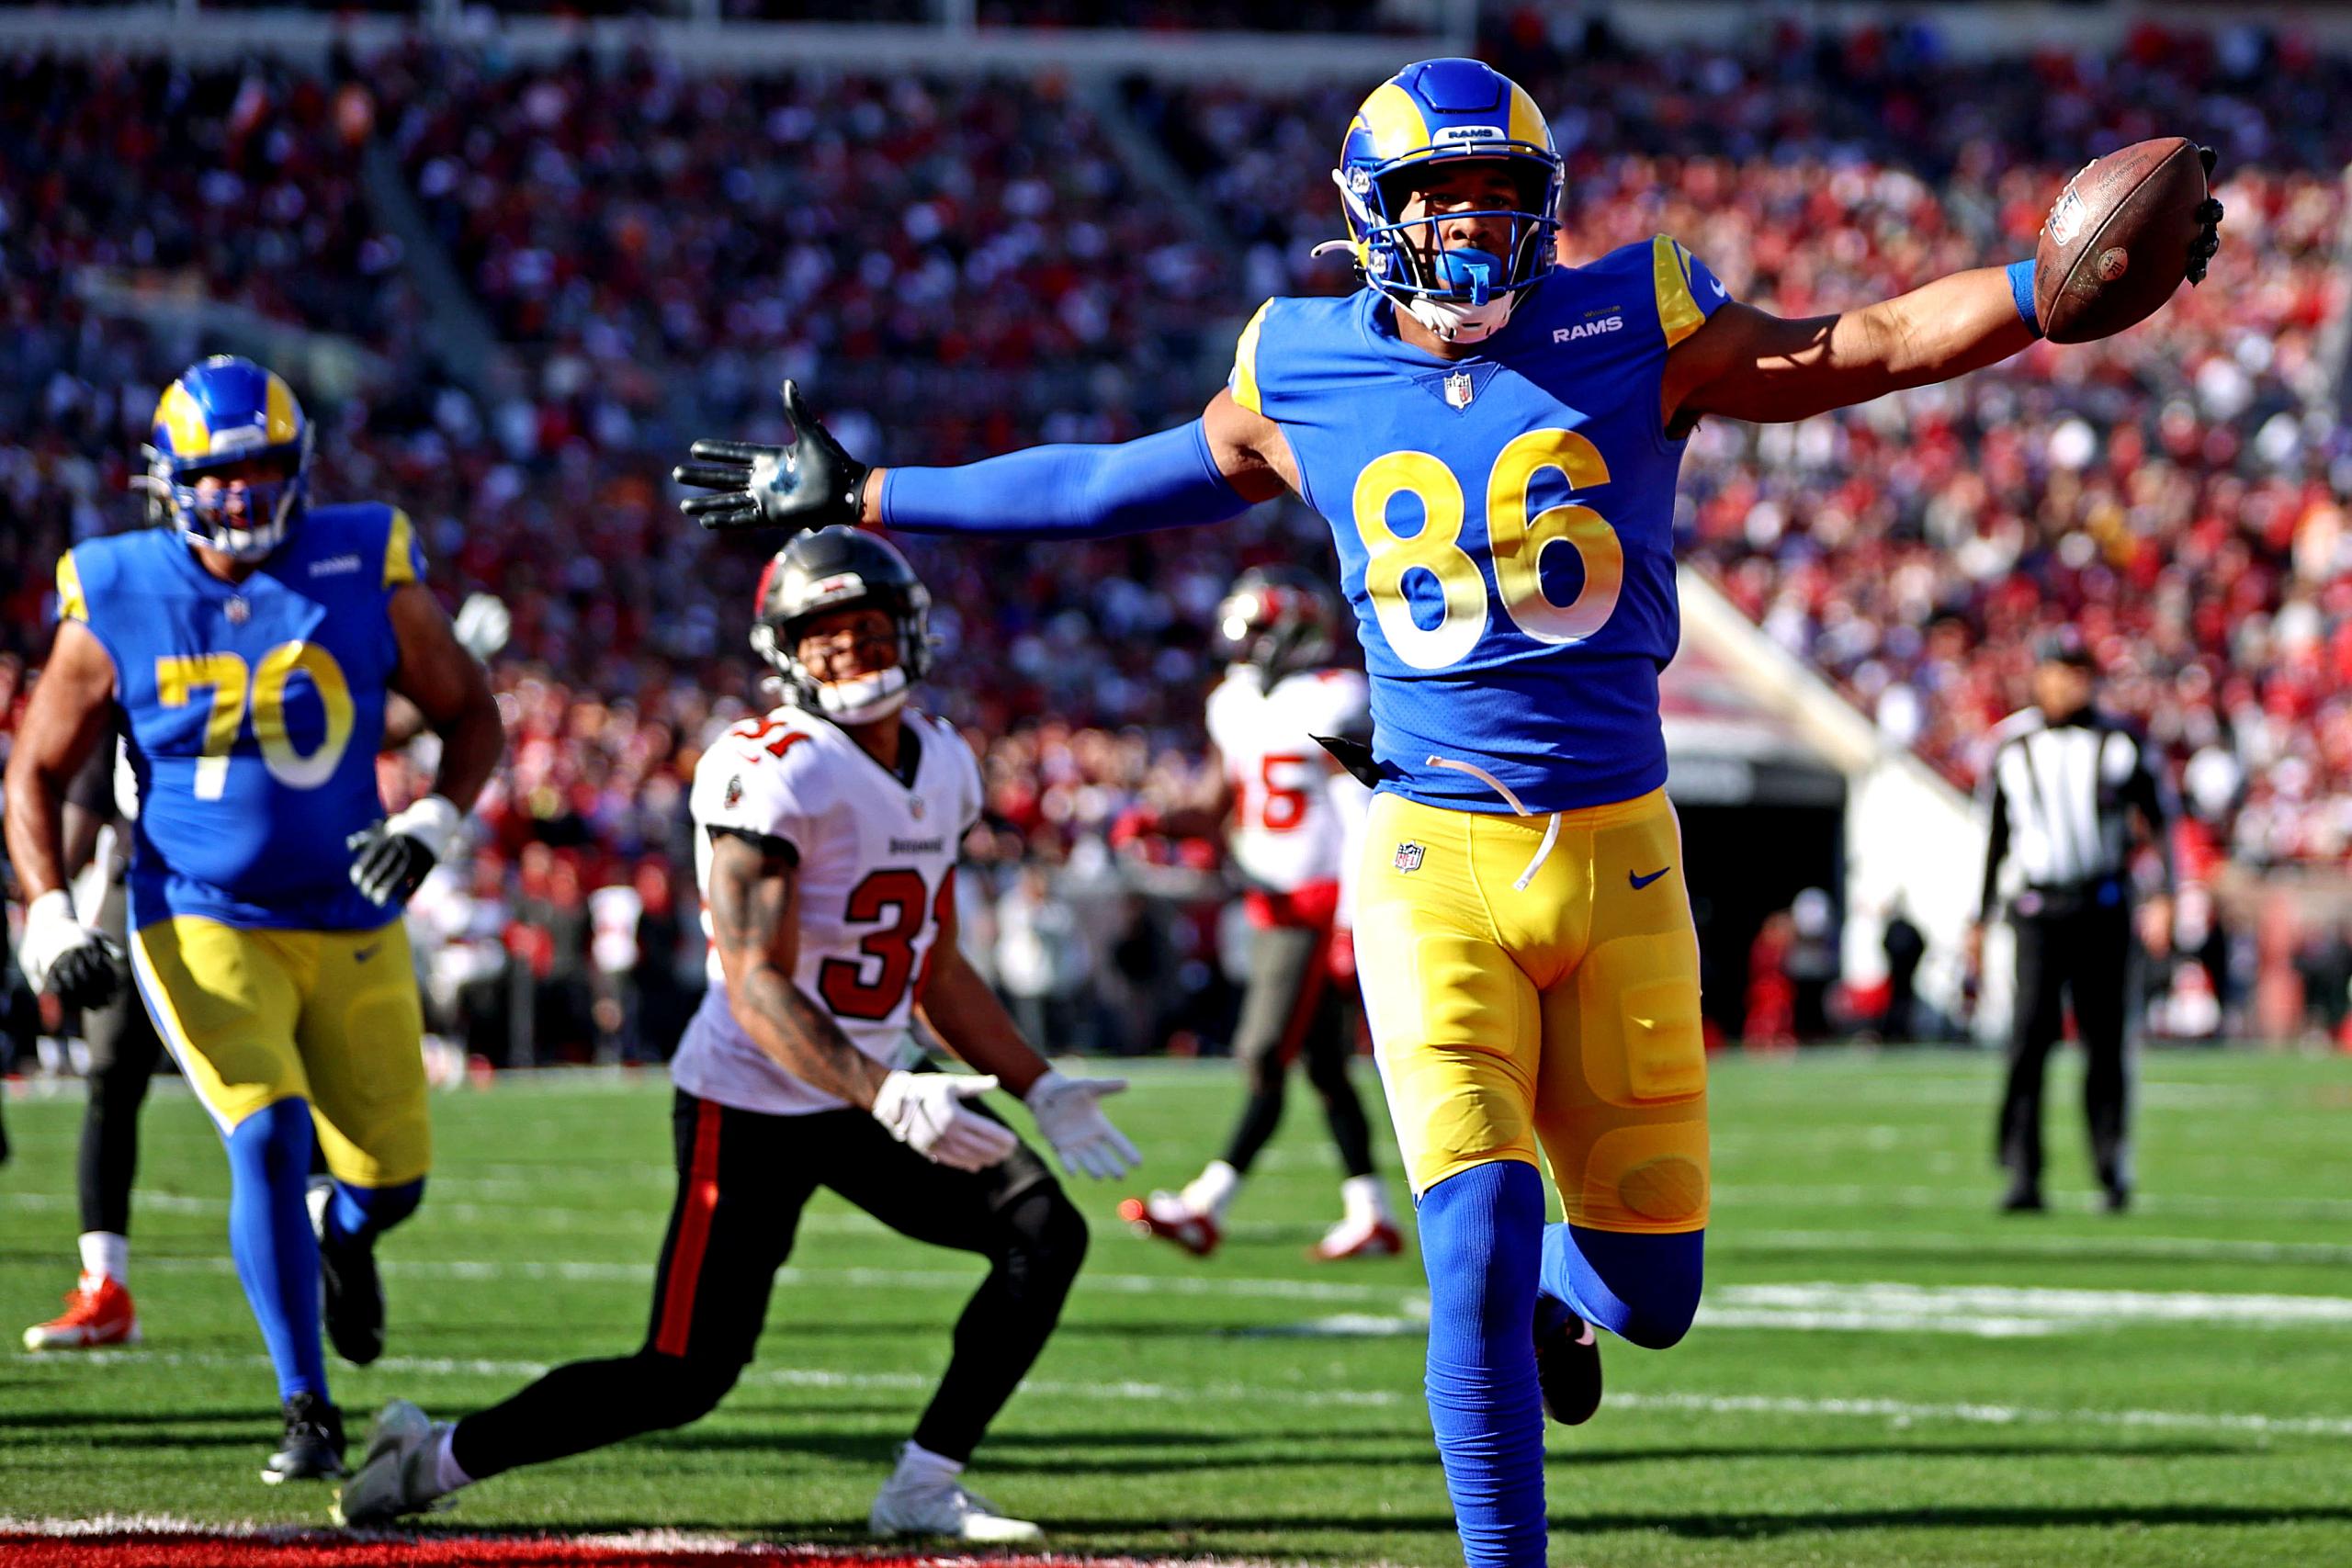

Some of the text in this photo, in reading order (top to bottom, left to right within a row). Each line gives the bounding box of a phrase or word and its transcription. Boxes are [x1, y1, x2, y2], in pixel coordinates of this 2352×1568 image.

[1448, 129, 1493, 140] RAMS
[1553, 315, 1623, 344] RAMS
[1352, 427, 1623, 669] 86
[155, 641, 355, 800] 70
